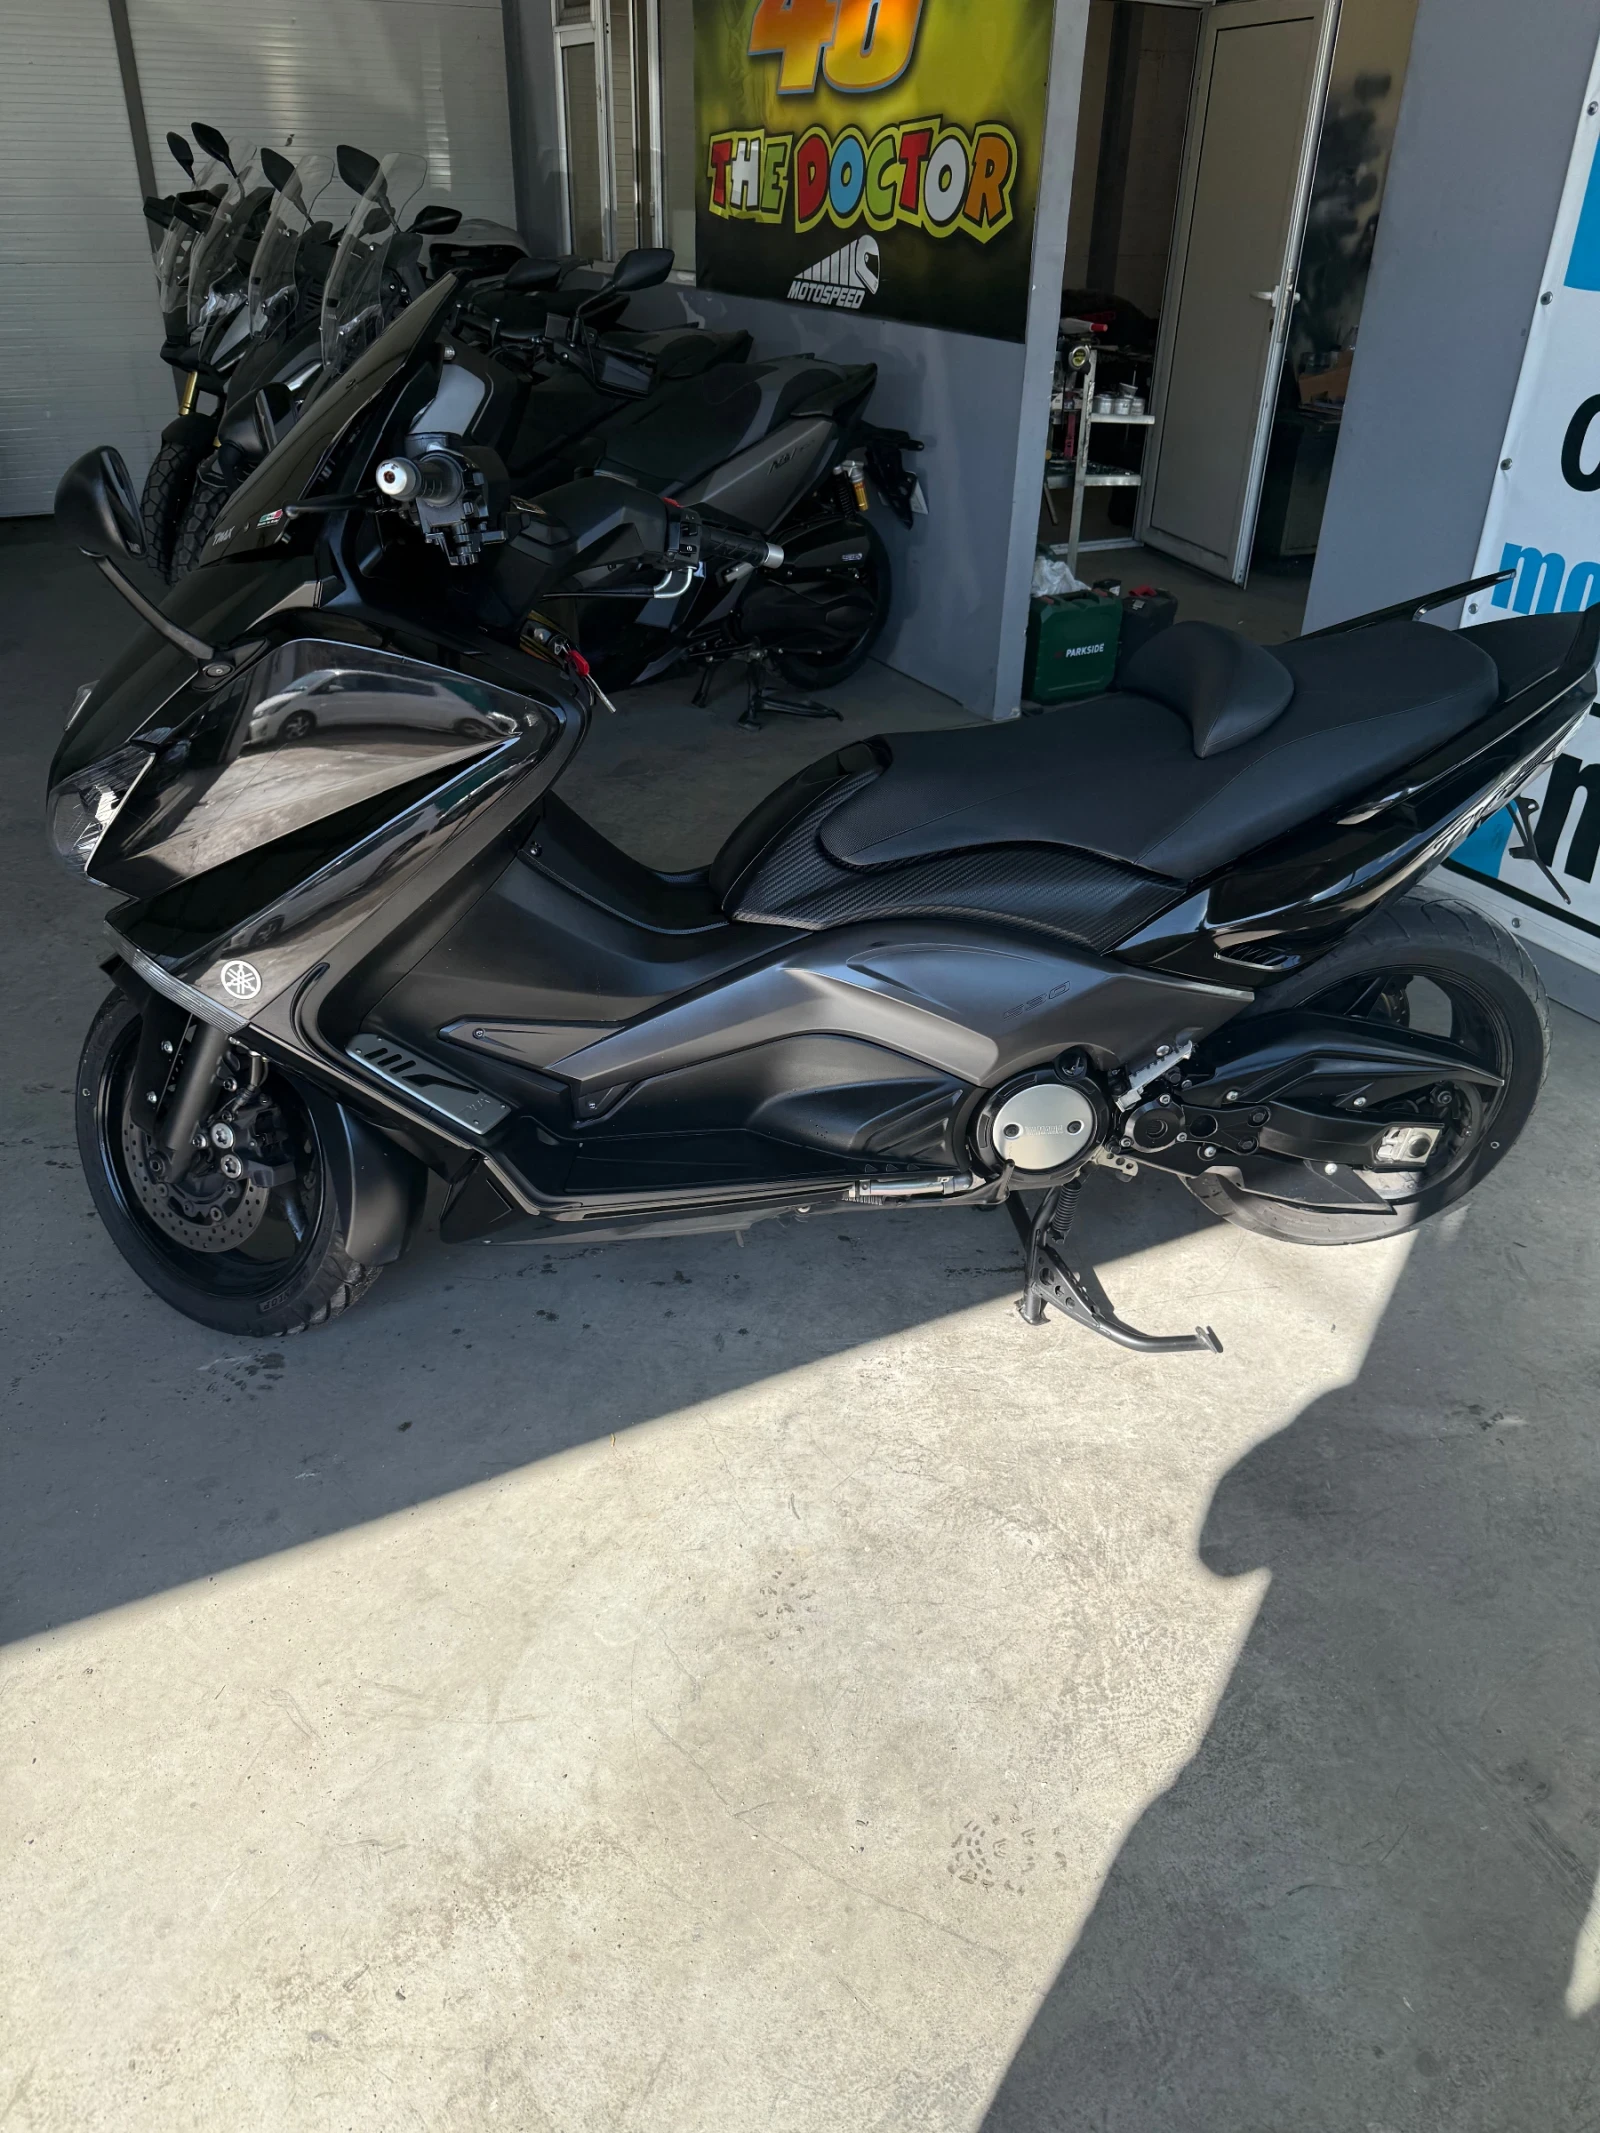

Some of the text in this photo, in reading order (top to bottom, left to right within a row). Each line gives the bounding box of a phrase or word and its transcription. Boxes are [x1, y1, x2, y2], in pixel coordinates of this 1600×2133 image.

[707, 122, 1014, 234] THE DOCTOR
[787, 280, 866, 309] MOTOSPEED
[1065, 643, 1105, 658] PARKSIDE
